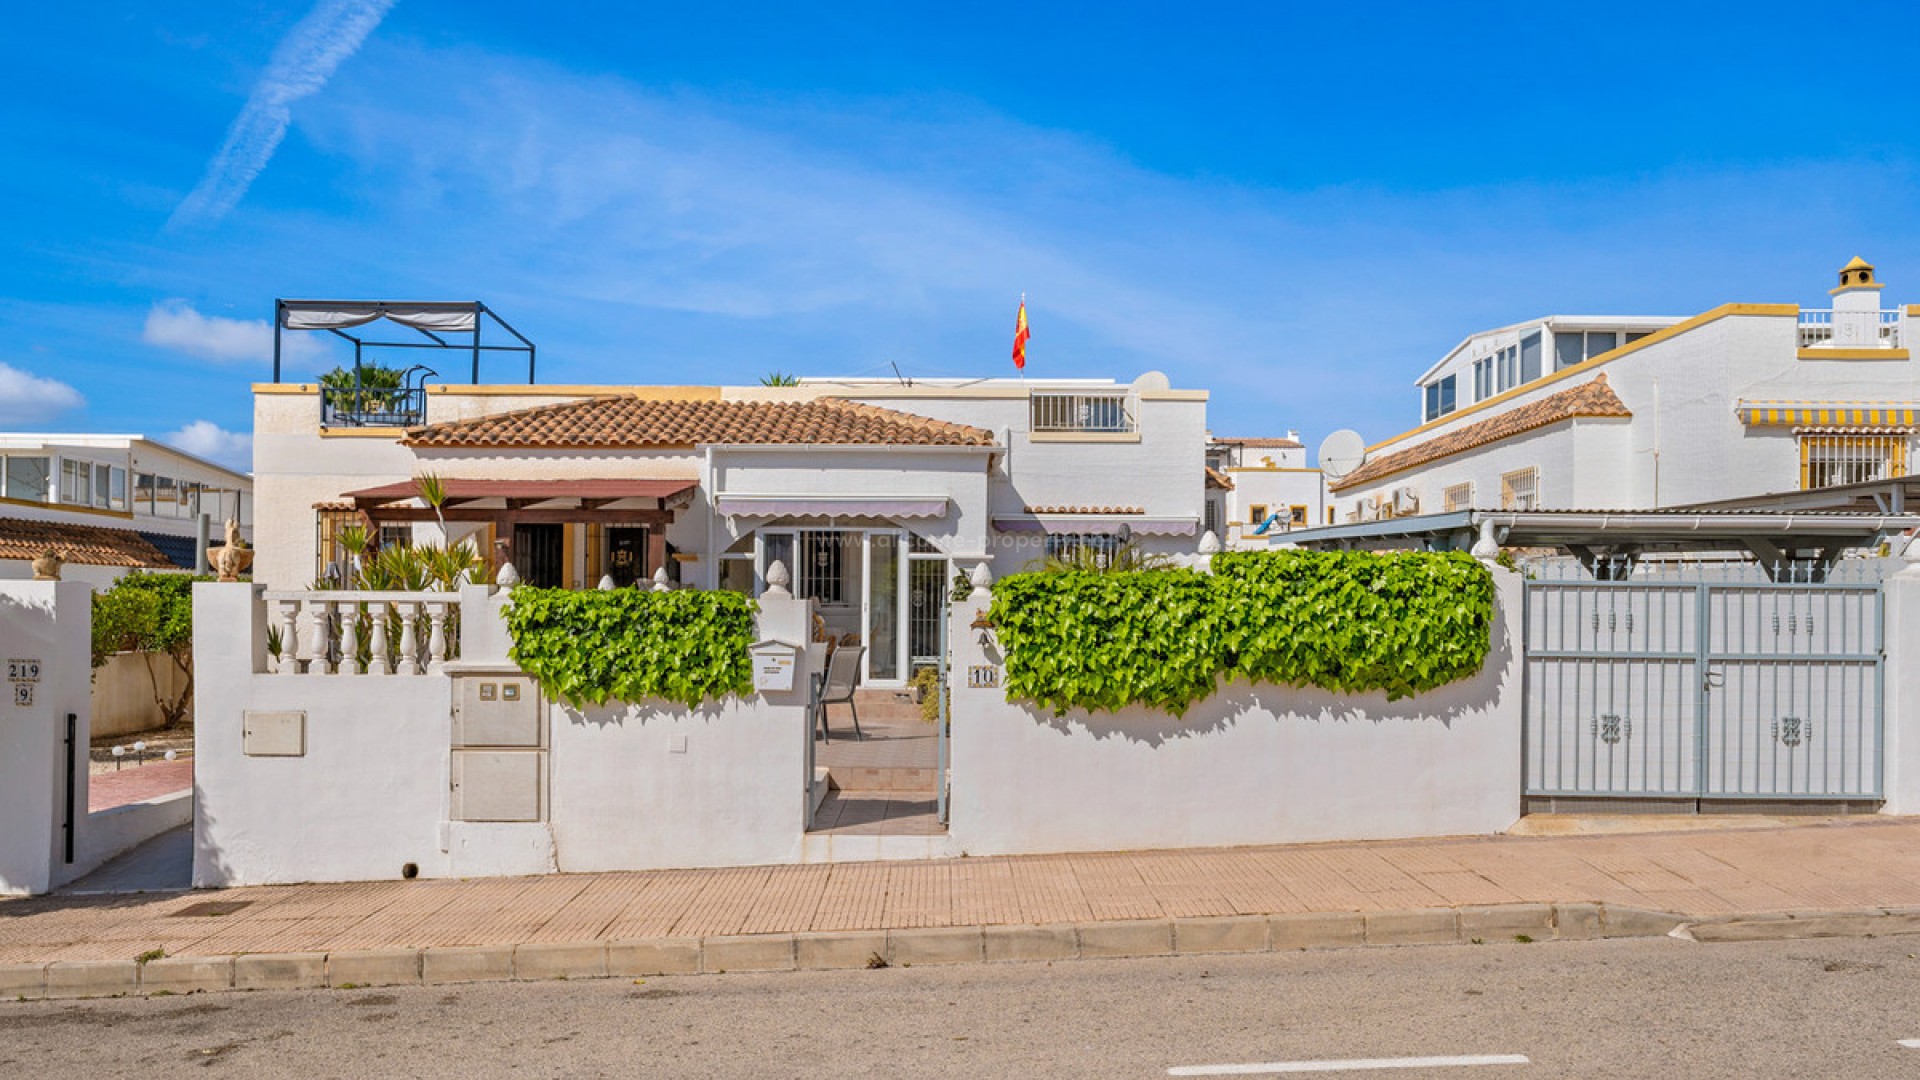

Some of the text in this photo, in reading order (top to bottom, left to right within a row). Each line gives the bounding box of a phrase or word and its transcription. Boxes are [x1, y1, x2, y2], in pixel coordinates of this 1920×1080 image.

[9, 664, 39, 677] 219
[974, 669, 993, 684] 10
[20, 688, 28, 701] 9
